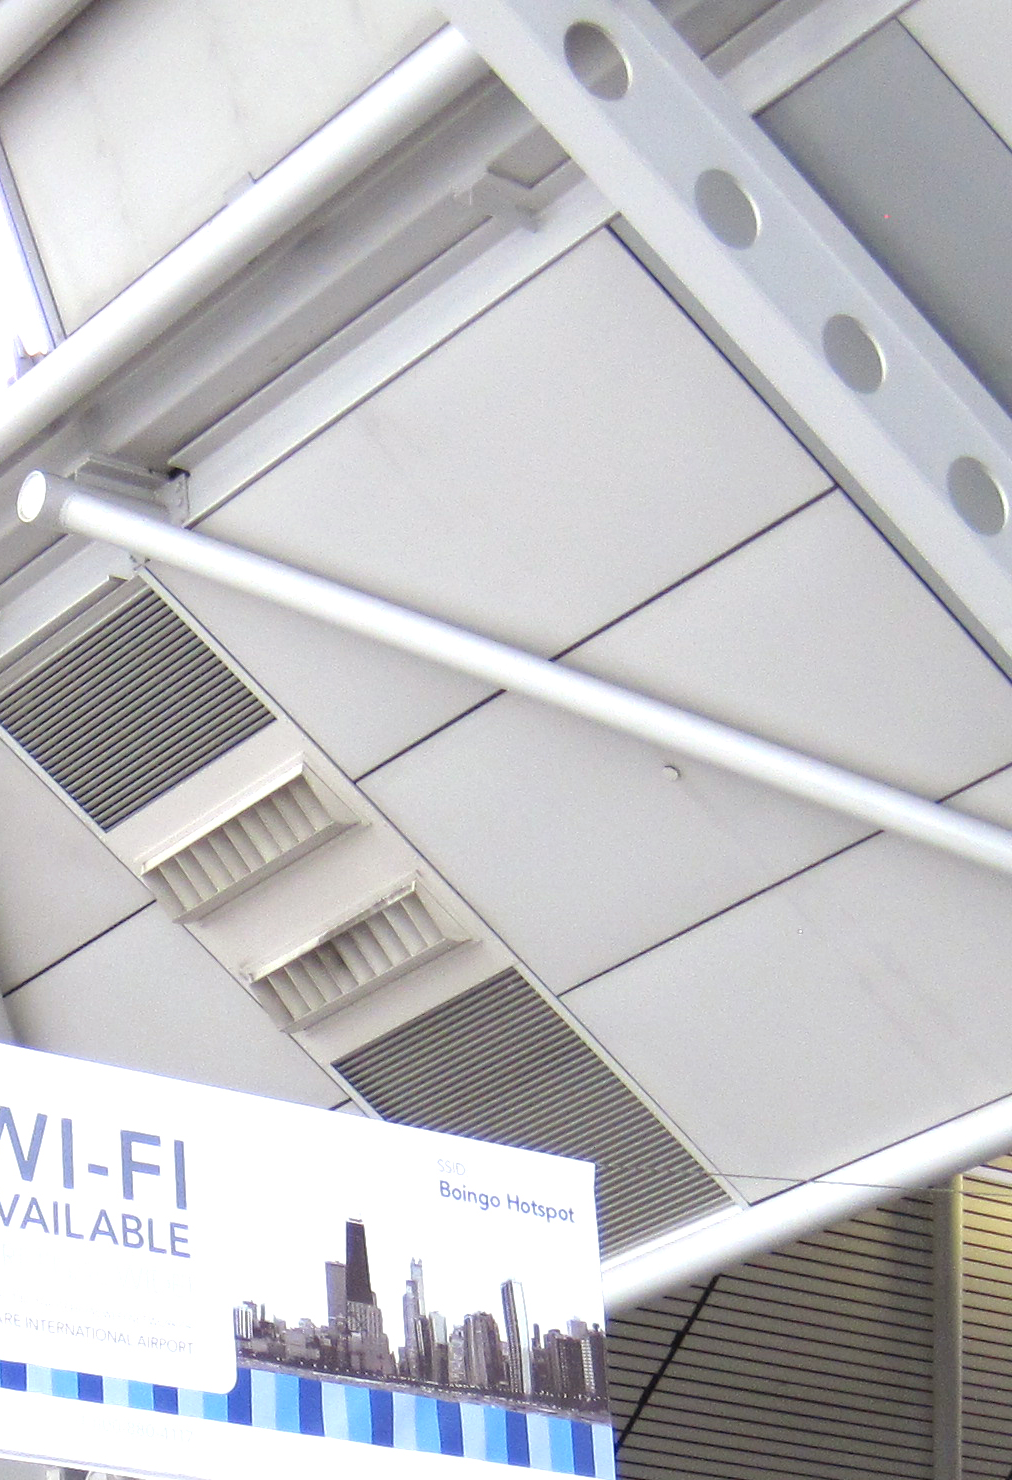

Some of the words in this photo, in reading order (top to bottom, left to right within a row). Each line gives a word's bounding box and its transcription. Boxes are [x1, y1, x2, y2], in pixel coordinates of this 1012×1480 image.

[437, 1158, 466, 1176] SSID
[439, 1179, 501, 1211] Boingo
[506, 1192, 575, 1223] Hotspot
[25, 1316, 132, 1346] INTERNATIONAL
[137, 1334, 194, 1355] AIRPORT
